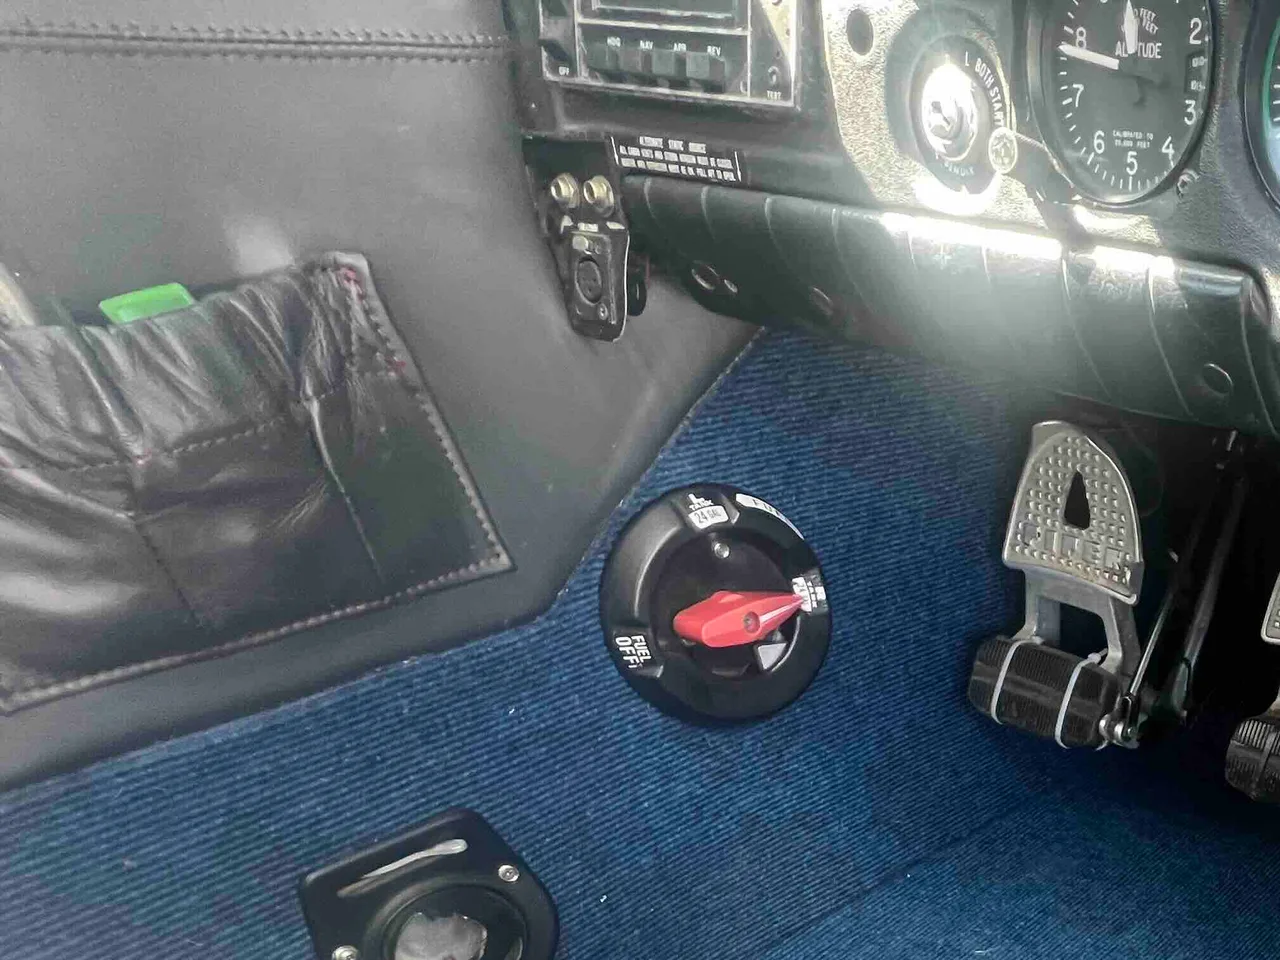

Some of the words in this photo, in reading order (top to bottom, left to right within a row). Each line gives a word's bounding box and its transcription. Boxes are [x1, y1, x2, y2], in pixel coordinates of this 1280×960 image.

[1075, 26, 1087, 49] 8
[1190, 17, 1202, 45] 2
[1115, 41, 1162, 58] ALTUDE
[975, 58, 994, 88] BOTH
[990, 86, 1005, 127] START
[1072, 84, 1084, 107] 7
[1184, 100, 1196, 125] 3
[1093, 131, 1105, 154] 6
[1161, 136, 1175, 158] 4
[1126, 151, 1138, 175] 5
[1022, 522, 1121, 570] PIPER
[615, 636, 637, 667] OFF
[631, 635, 652, 662] FUEL
